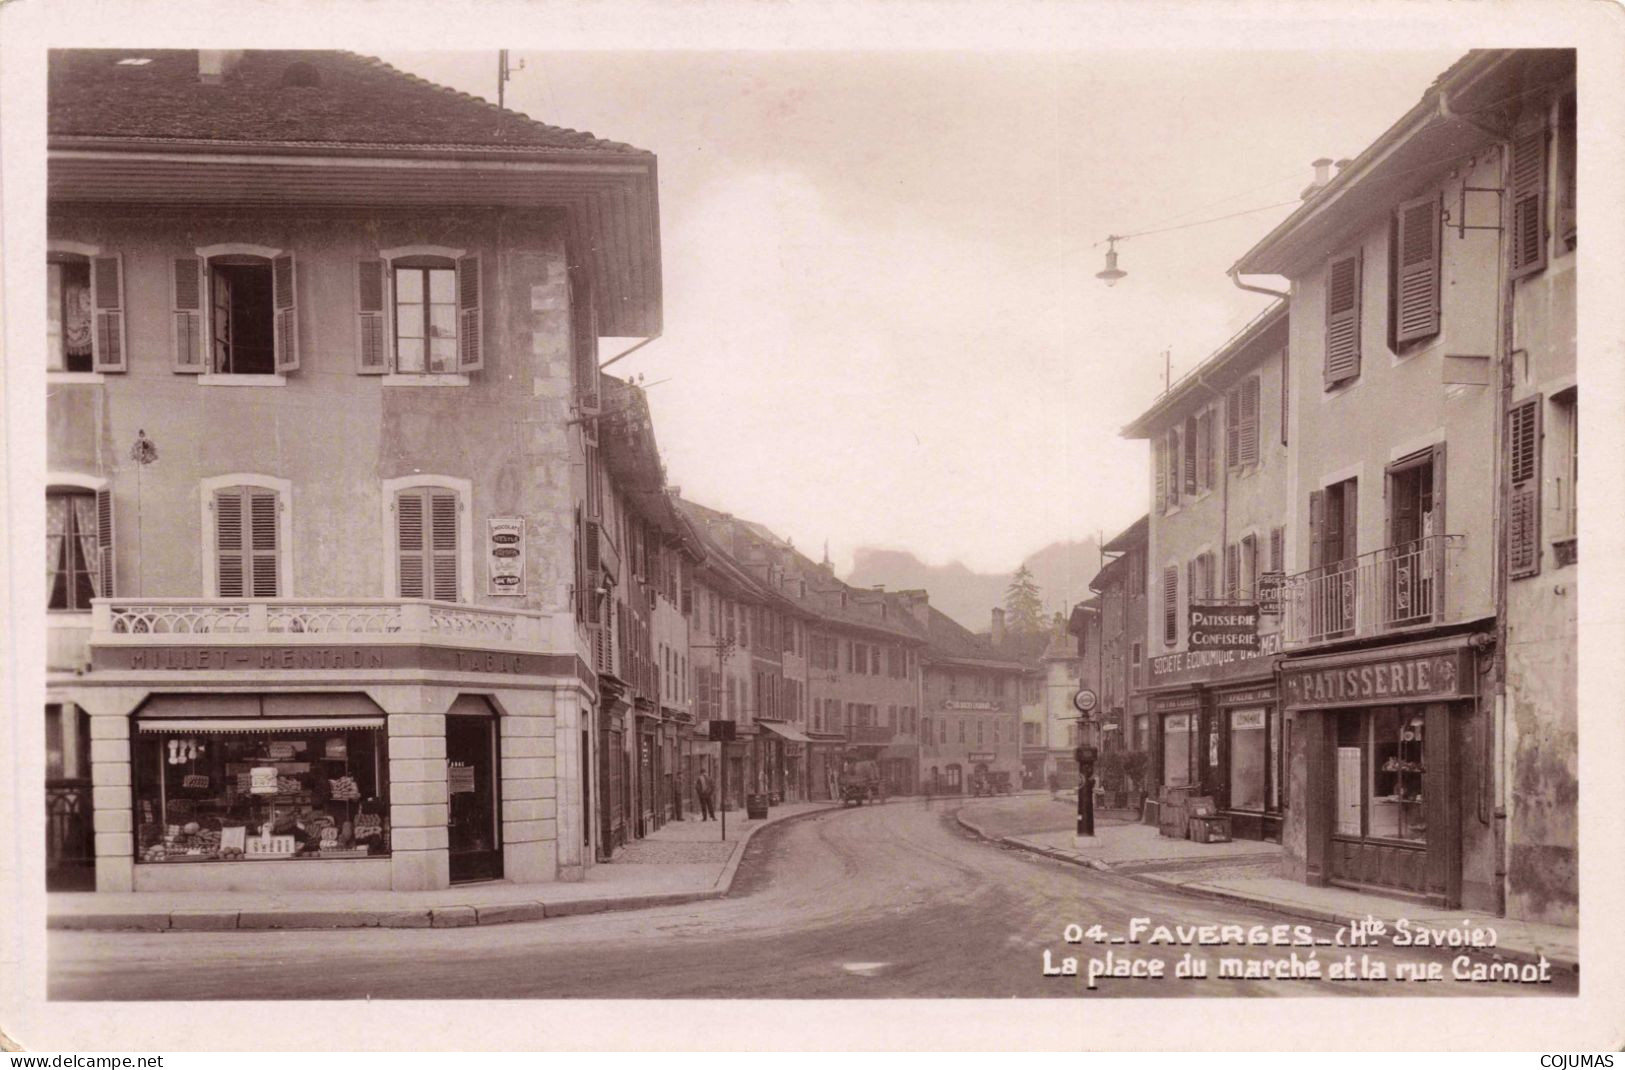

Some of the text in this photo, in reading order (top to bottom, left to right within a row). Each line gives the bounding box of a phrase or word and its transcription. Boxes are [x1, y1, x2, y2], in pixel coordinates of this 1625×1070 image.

[1192, 612, 1256, 626] PATISSERIE
[1192, 631, 1256, 645] CONFISERIE
[131, 651, 229, 670] MILLET
[259, 651, 385, 670] MENTHON
[454, 652, 523, 674] TABAC
[1303, 661, 1431, 700] PATISSERIE
